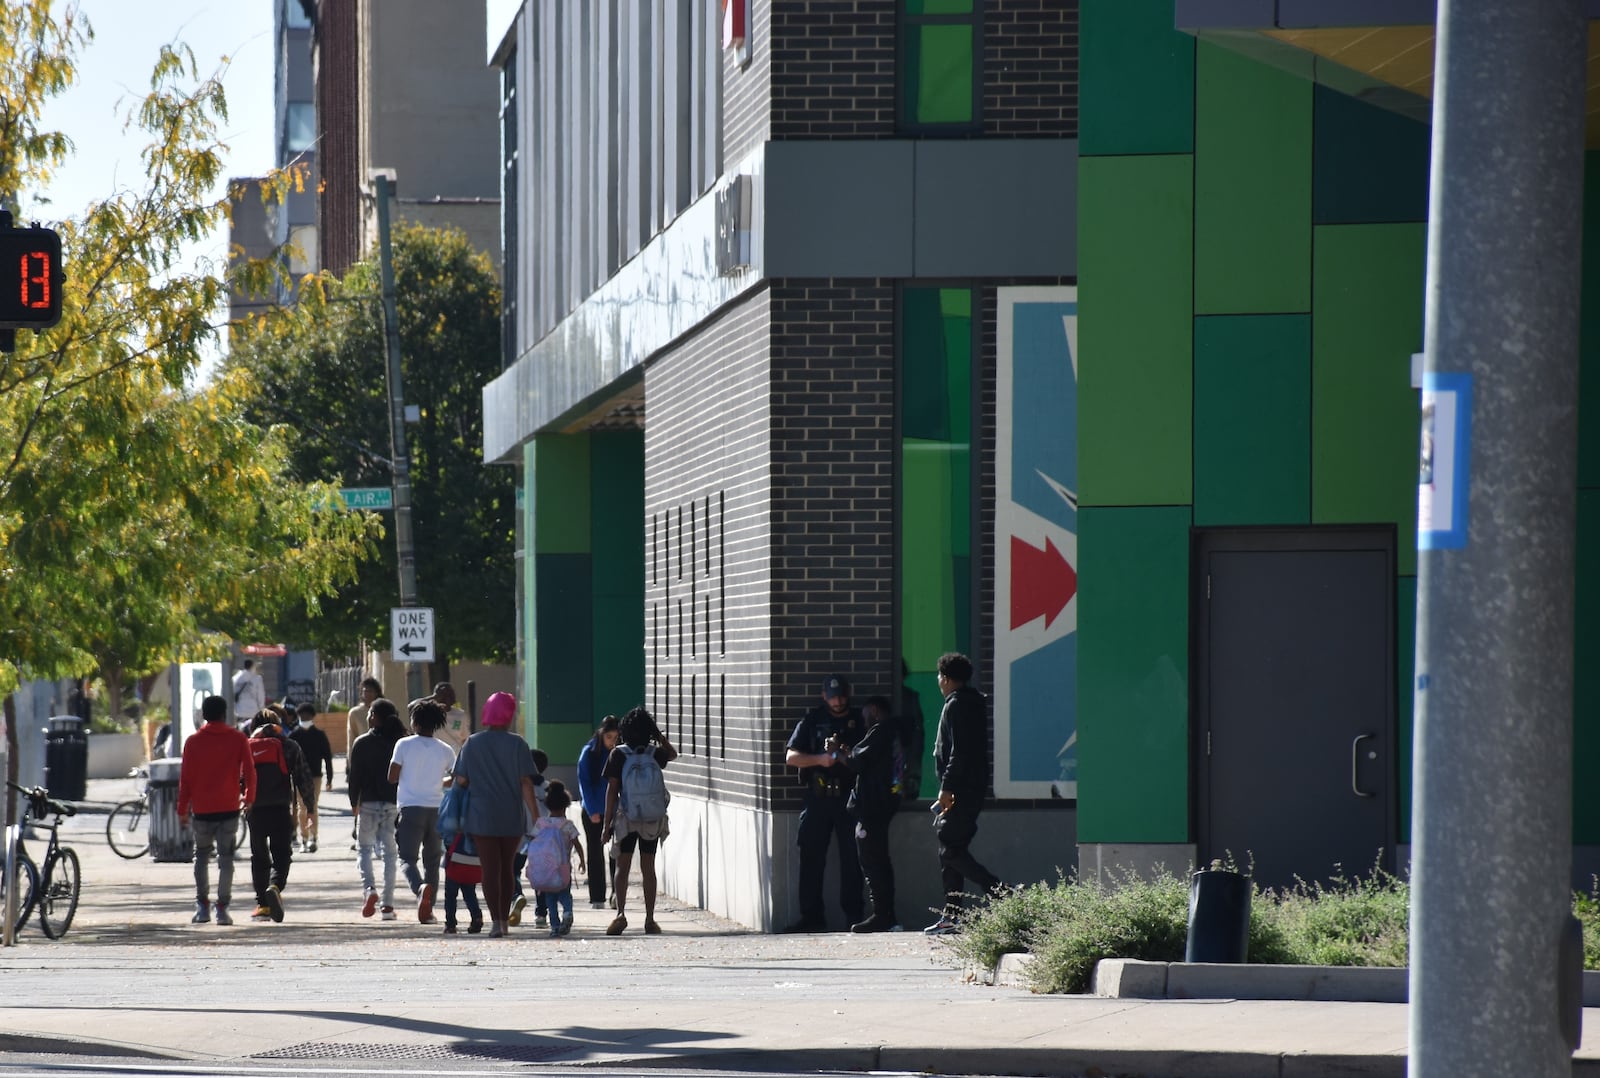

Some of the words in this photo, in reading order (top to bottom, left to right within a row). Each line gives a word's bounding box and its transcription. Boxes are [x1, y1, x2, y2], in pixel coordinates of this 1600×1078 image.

[20, 251, 51, 309] 13
[399, 612, 427, 625] ONE
[398, 627, 428, 639] WAY
